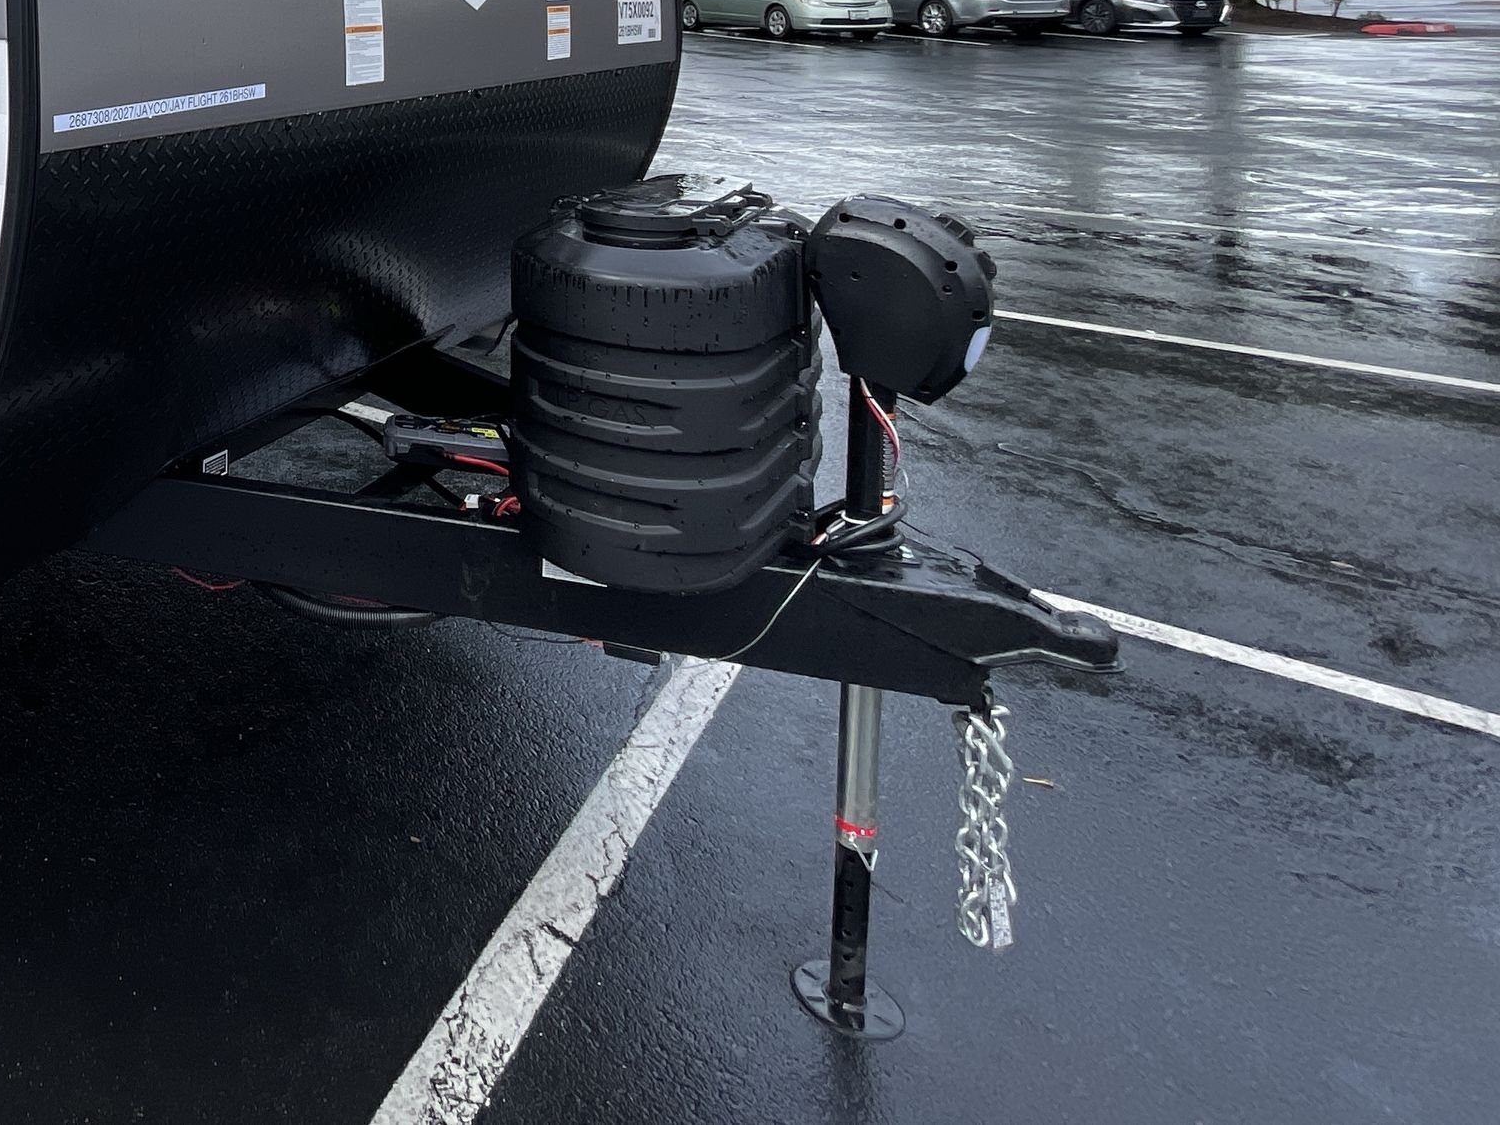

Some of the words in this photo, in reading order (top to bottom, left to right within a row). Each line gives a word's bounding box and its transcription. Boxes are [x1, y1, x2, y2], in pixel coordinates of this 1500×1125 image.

[188, 92, 218, 108] FLIGHT
[220, 87, 257, 103] 261BHSW
[587, 396, 647, 426] GAS
